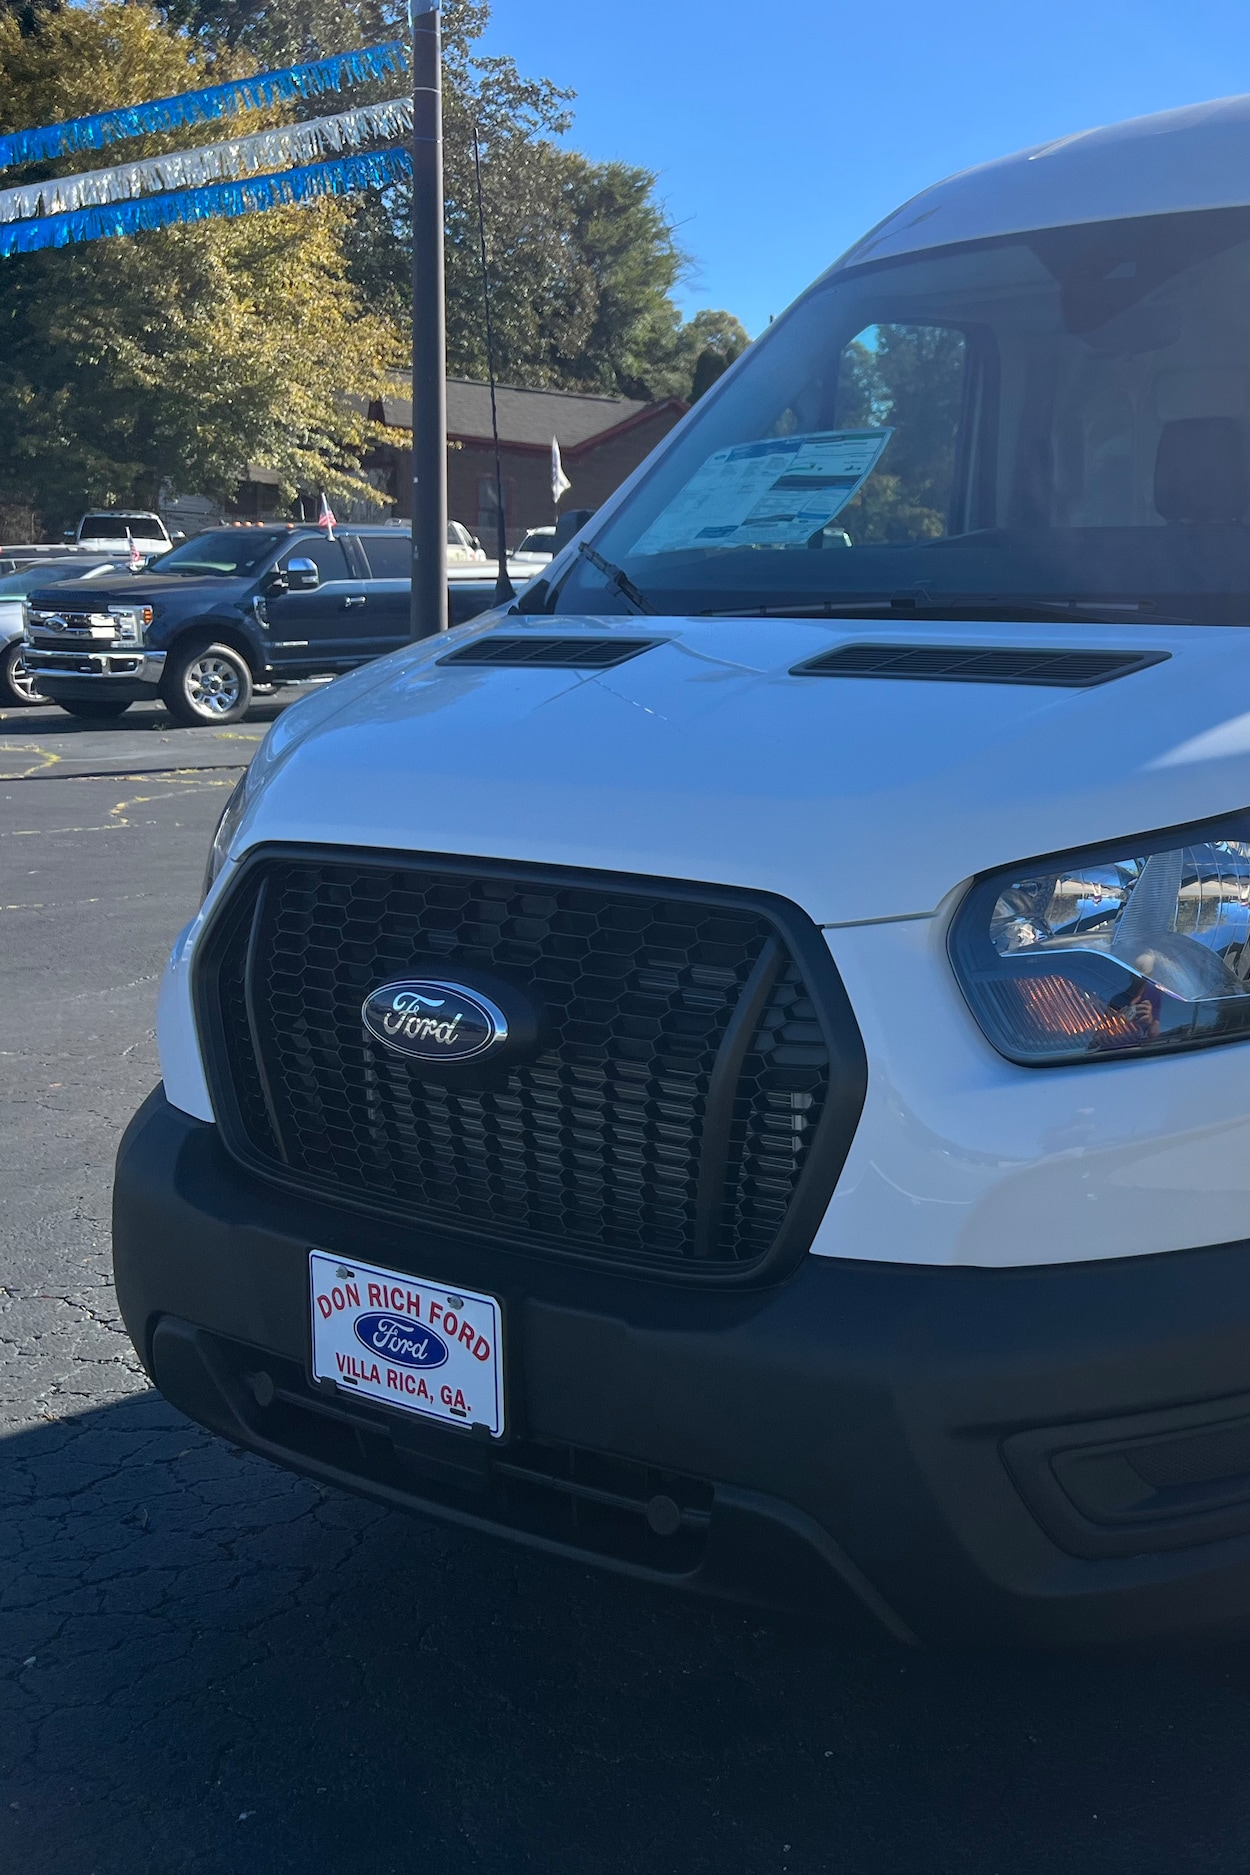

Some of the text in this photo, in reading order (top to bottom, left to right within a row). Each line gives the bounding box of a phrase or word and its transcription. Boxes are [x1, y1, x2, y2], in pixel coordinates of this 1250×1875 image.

[384, 991, 464, 1045] Ford
[316, 1283, 491, 1362] DON RICH FORD
[372, 1318, 429, 1360] Ford
[335, 1351, 472, 1412] VILLA RICA, GA.
